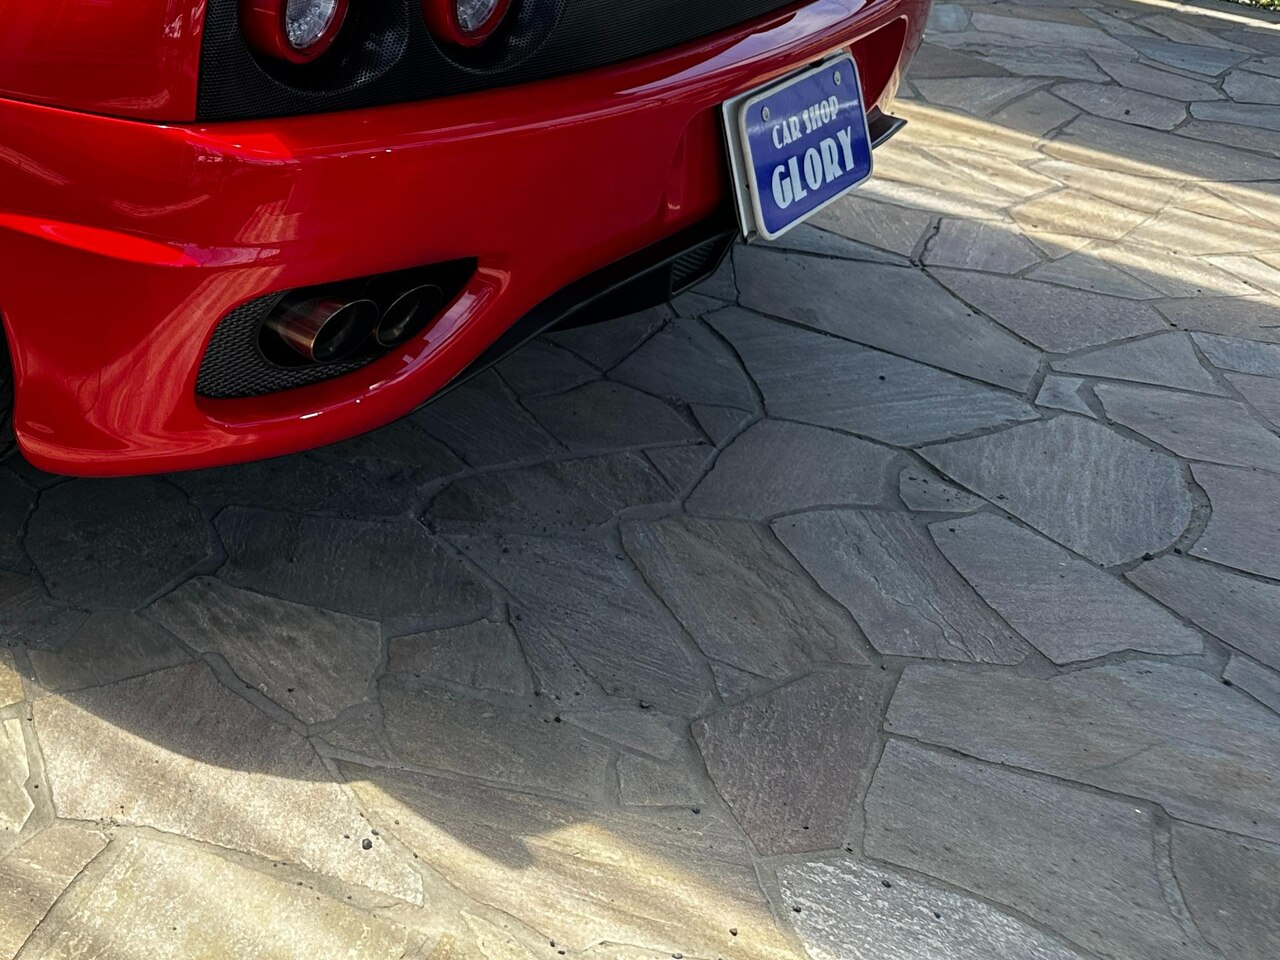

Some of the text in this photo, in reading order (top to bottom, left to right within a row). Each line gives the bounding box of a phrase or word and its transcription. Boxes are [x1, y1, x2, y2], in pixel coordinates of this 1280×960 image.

[771, 95, 839, 150] CAR SHOP
[771, 125, 855, 210] GLORY
